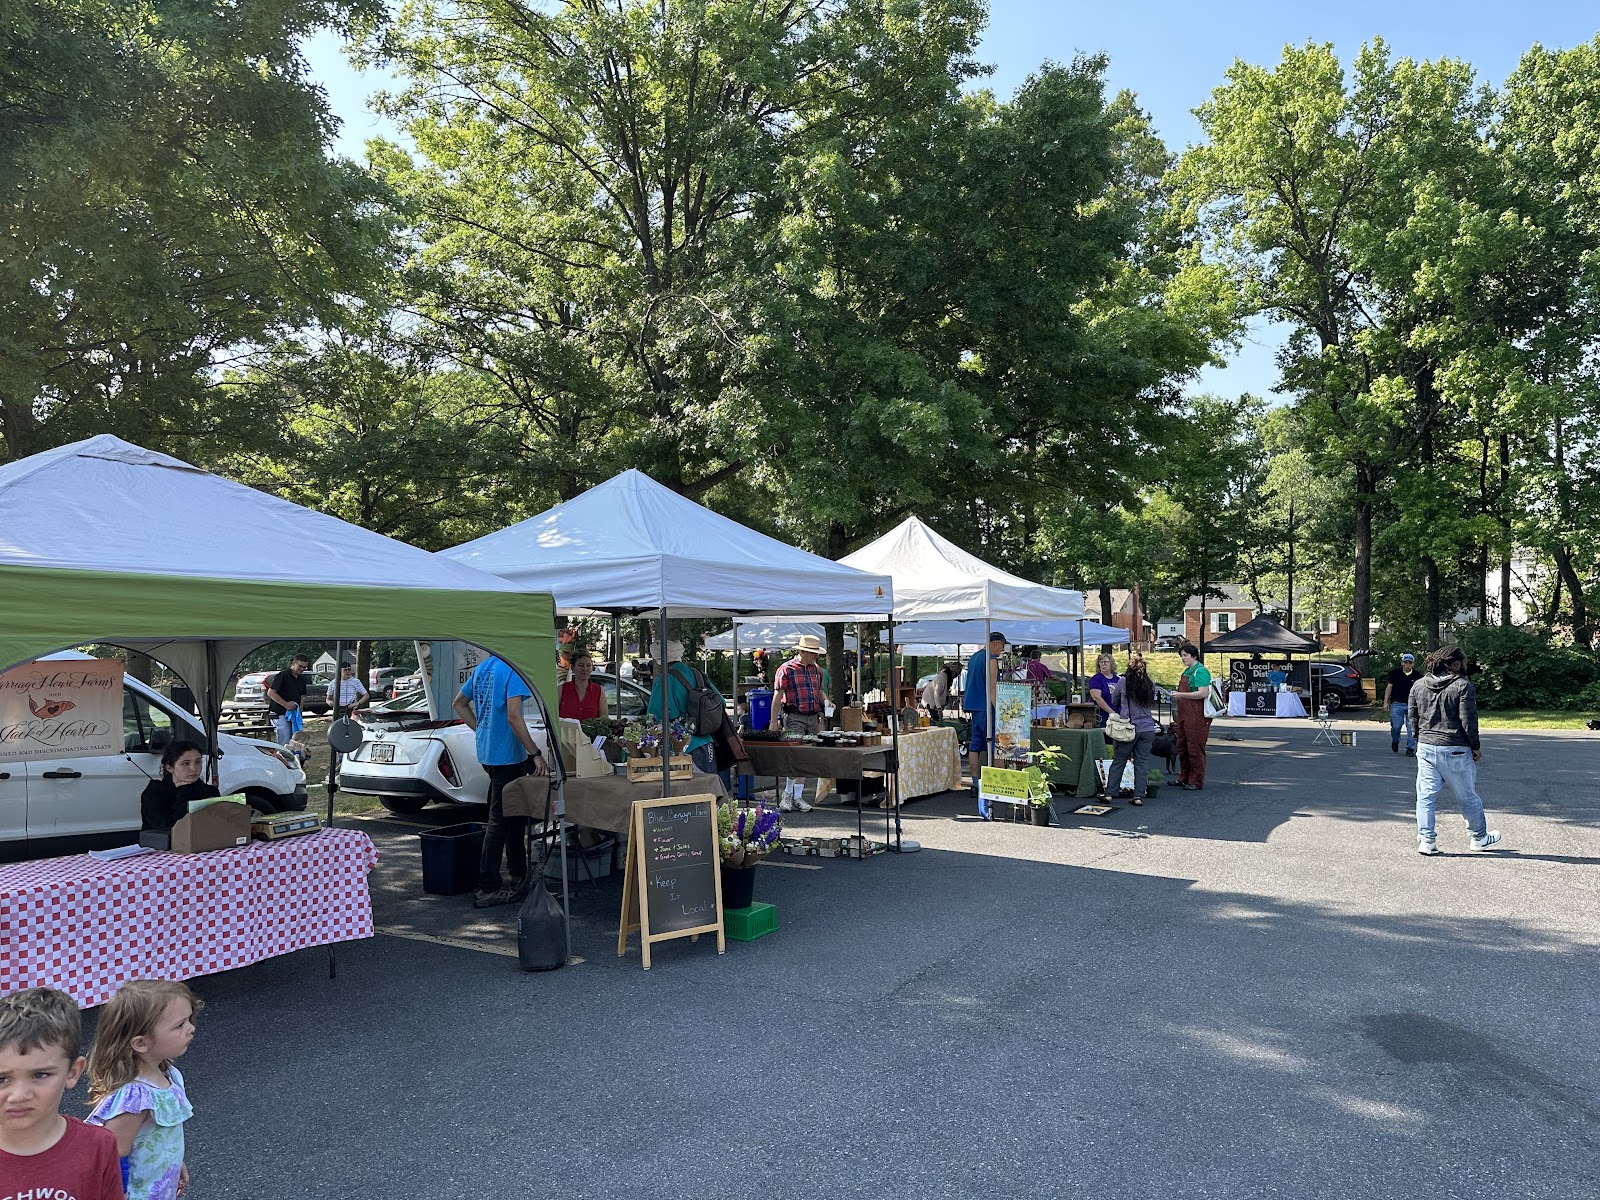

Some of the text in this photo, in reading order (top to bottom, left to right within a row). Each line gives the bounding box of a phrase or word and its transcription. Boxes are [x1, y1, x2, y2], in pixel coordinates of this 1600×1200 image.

[1248, 662, 1270, 670] Local
[0, 675, 37, 694] arriage
[70, 672, 116, 689] Farms
[43, 719, 110, 746] Hearts
[35, 745, 88, 755] DISCRIMINATING
[648, 811, 664, 824] Blue
[655, 874, 677, 889] Keep
[670, 892, 681, 900] It
[681, 900, 708, 915] Local
[1, 1187, 77, 1200] HWO
